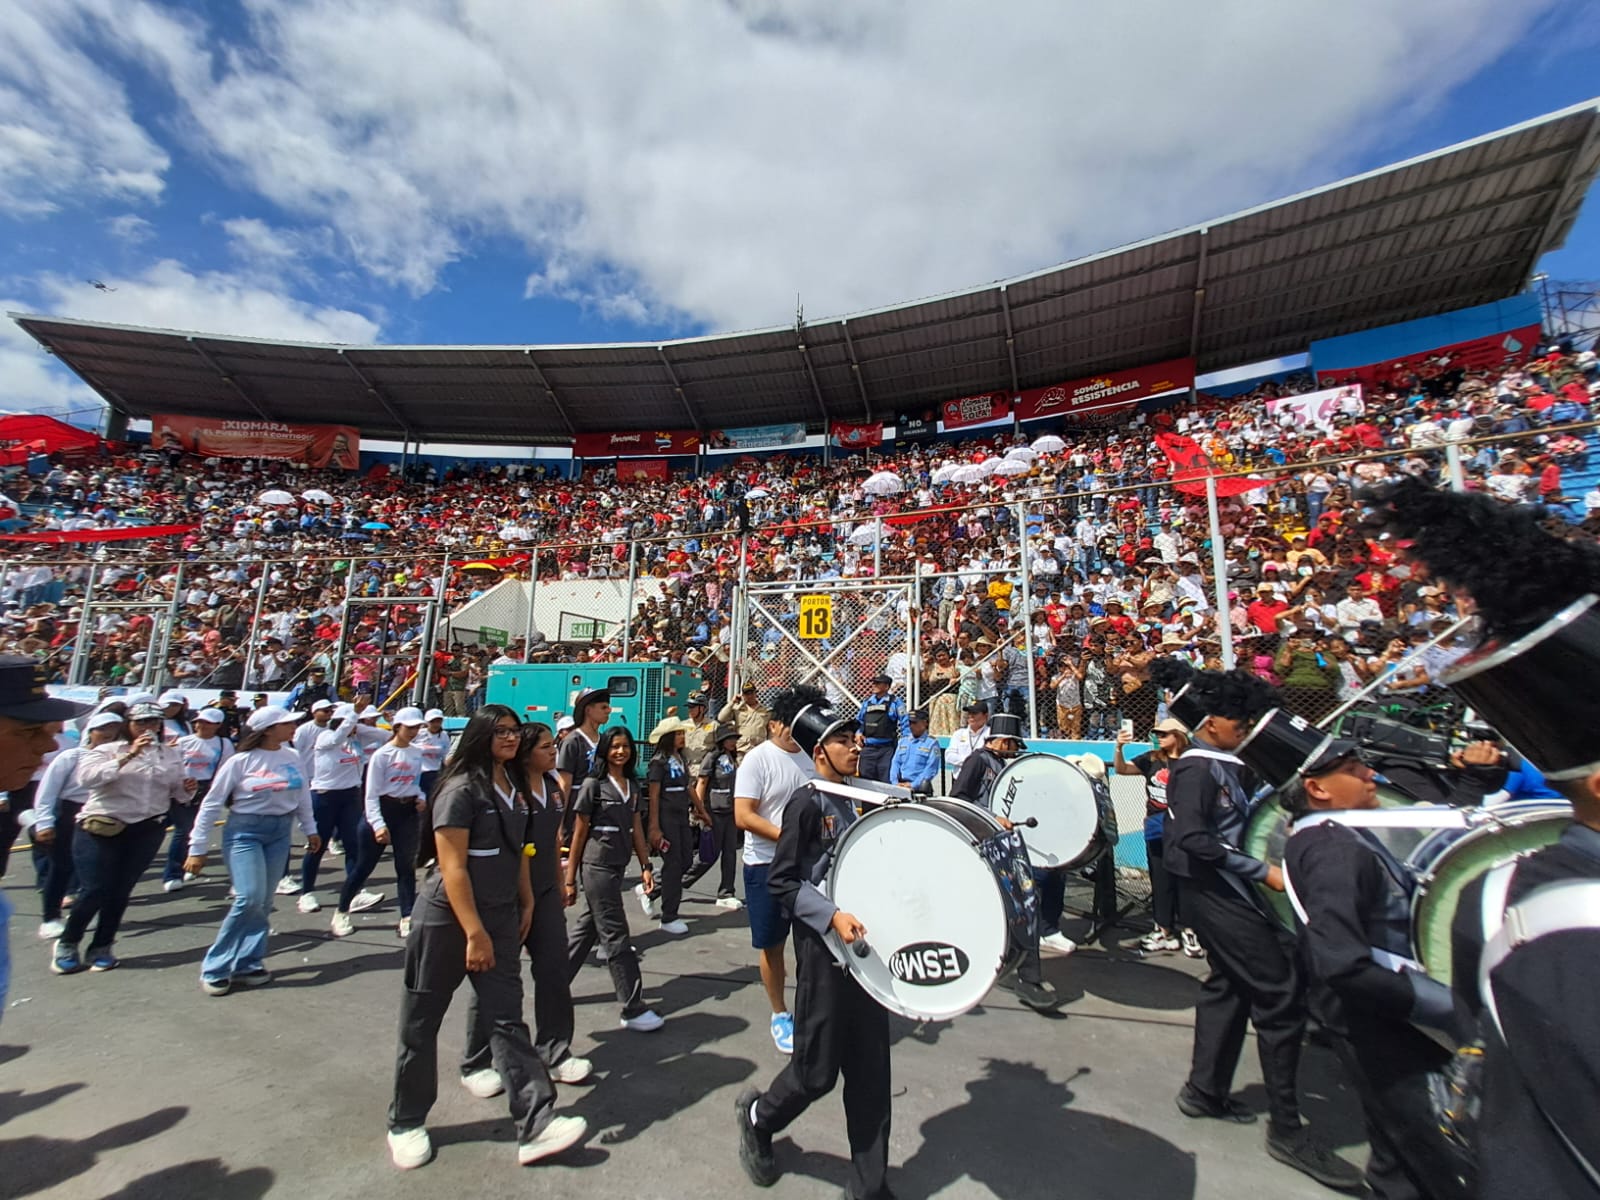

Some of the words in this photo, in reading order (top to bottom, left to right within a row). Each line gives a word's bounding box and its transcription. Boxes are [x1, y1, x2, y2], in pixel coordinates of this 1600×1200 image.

[1071, 380, 1141, 406] RESISTENCIA
[1073, 382, 1105, 396] SOMOS
[908, 420, 922, 428] NO
[572, 623, 605, 637] SALIA
[803, 608, 829, 635] 13
[901, 947, 961, 981] ESM
